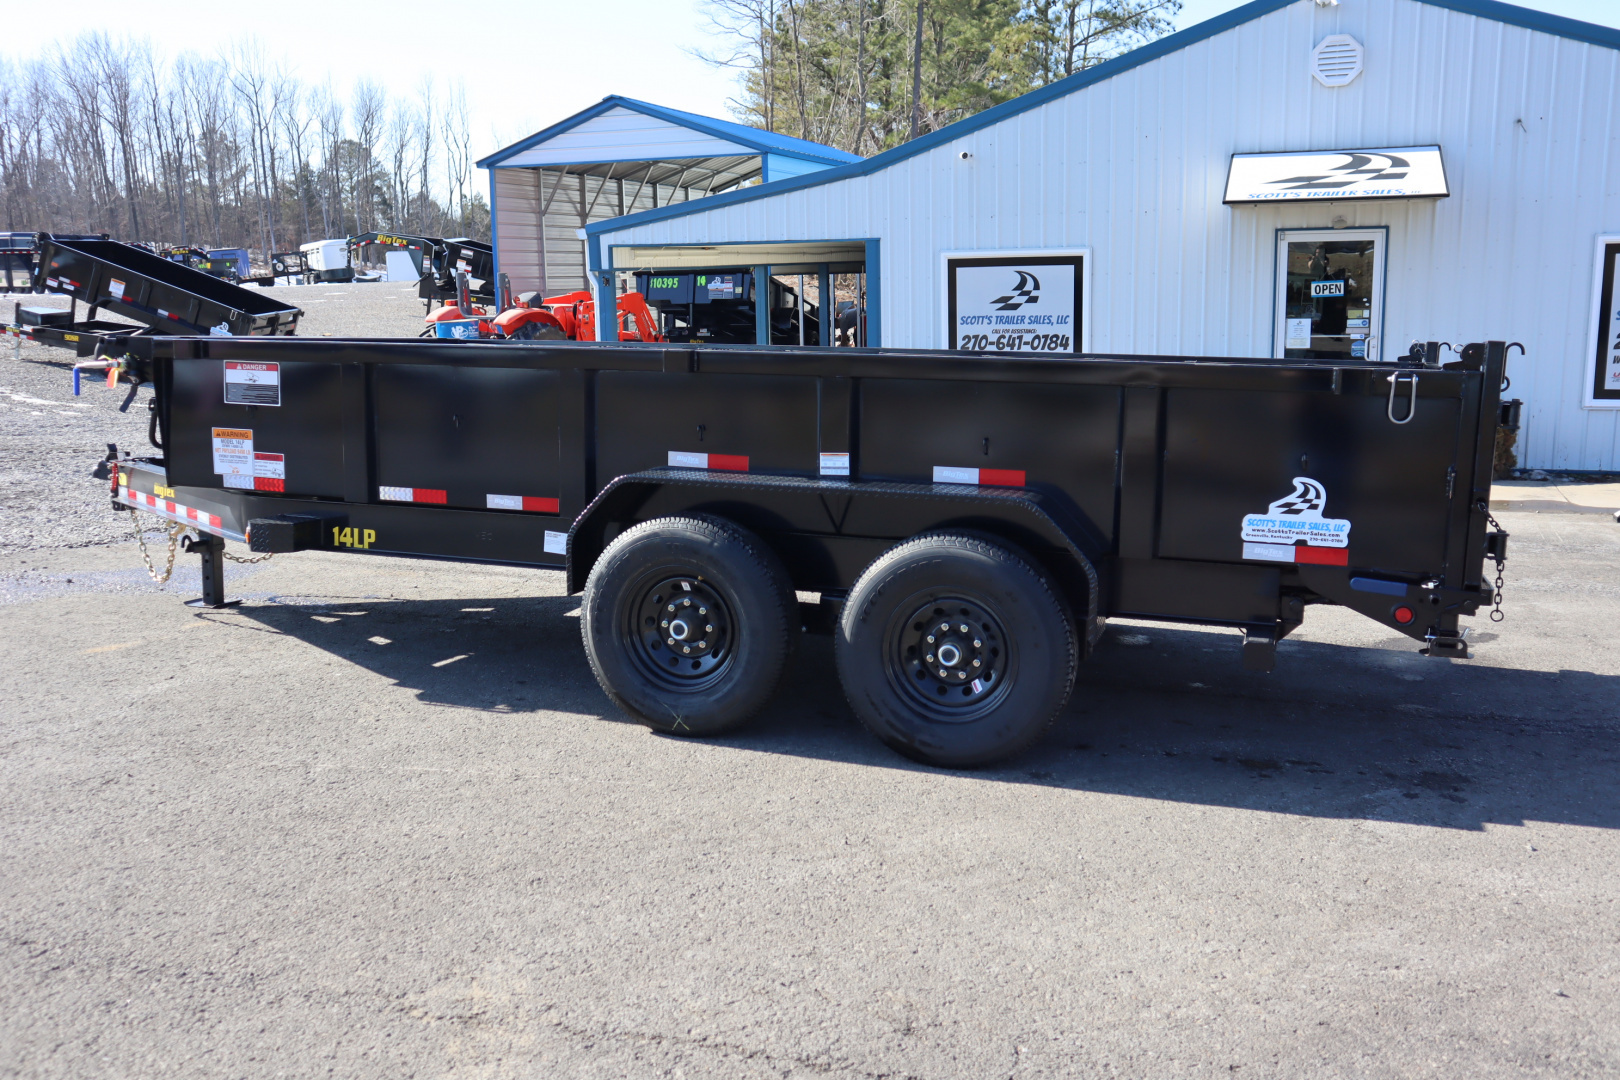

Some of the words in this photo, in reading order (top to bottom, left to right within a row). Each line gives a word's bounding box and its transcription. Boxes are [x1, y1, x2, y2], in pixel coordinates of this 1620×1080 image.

[1248, 191, 1300, 199] SCOTT'S
[1306, 190, 1358, 198] TRAILER
[1362, 188, 1406, 196] SALES,
[376, 234, 408, 246] BigTex
[1314, 284, 1342, 295] OPEN
[960, 315, 993, 326] SCOTT'S
[995, 315, 1026, 325] TRAILER
[1028, 314, 1054, 326] SALES,
[1056, 314, 1070, 325] LLC
[960, 334, 1070, 351] 270-641-0784
[242, 363, 267, 371] DANGER
[220, 431, 249, 439] WARNING
[1246, 518, 1277, 528] SCOTT'S
[1278, 520, 1307, 530] TRAILER
[1307, 522, 1332, 532] SALES,
[1333, 524, 1346, 532] LLC
[332, 526, 376, 549] 14LP
